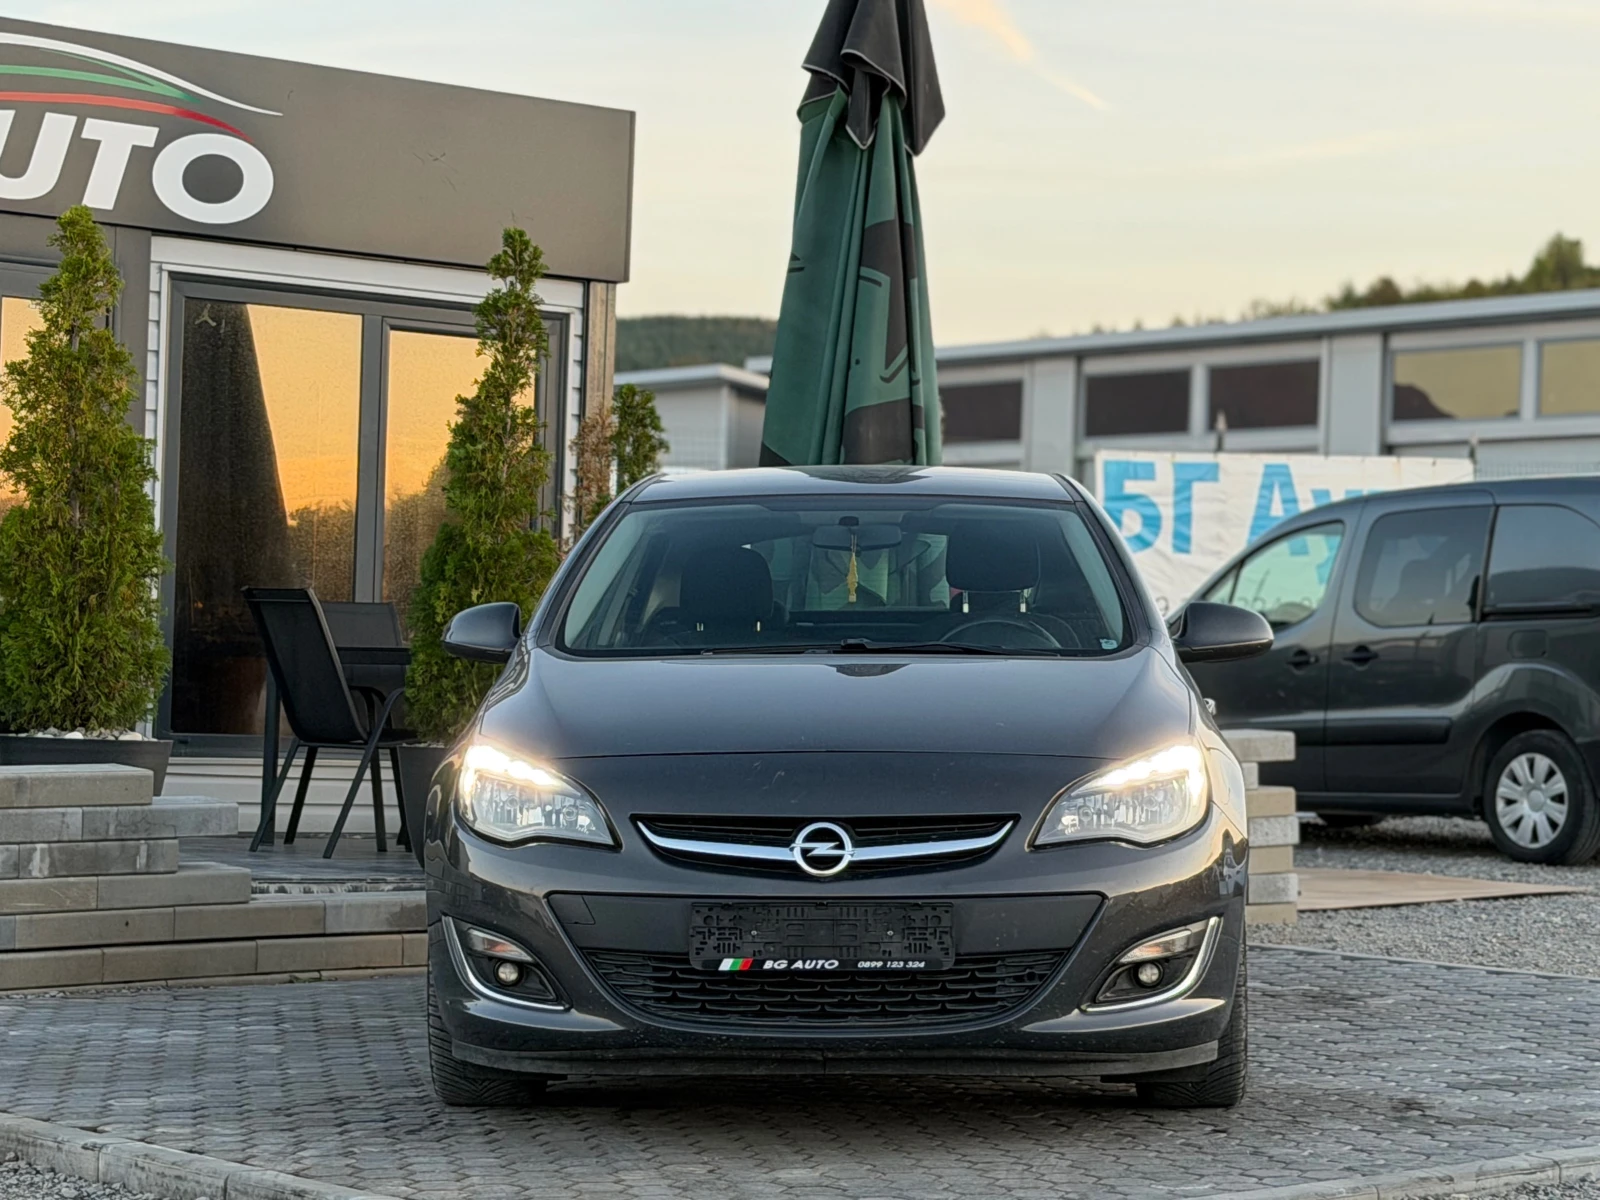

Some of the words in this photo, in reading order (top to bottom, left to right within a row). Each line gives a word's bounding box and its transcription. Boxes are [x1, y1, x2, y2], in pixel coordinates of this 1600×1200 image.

[1103, 460, 1220, 555] БГ
[763, 959, 788, 970] BG
[790, 959, 840, 970] AUTO
[857, 960, 884, 969] 0899
[886, 960, 906, 969] 123
[905, 960, 926, 969] 324
